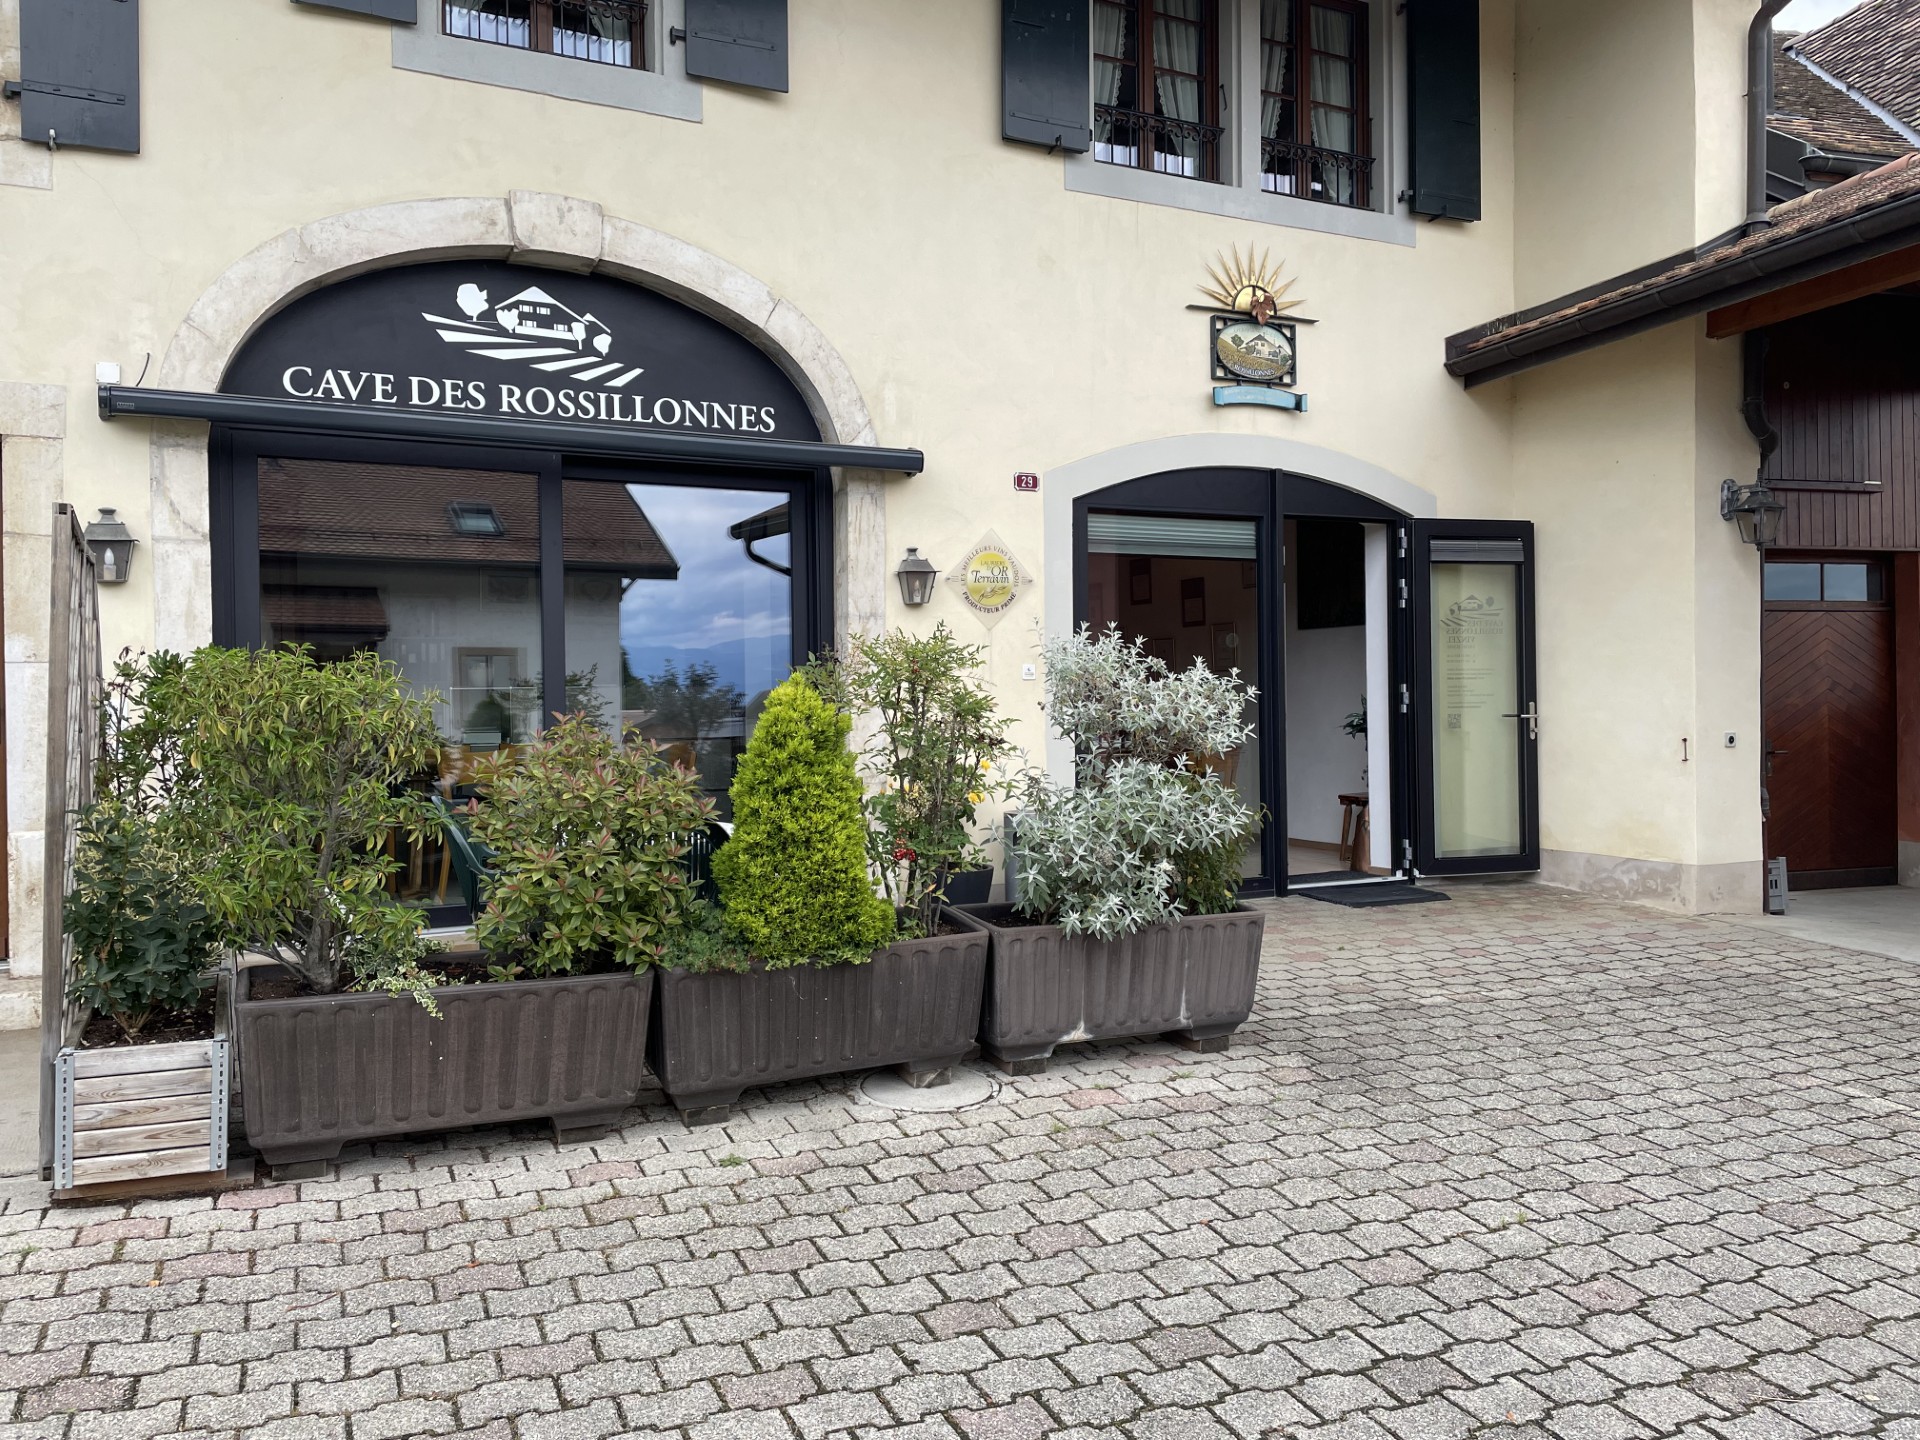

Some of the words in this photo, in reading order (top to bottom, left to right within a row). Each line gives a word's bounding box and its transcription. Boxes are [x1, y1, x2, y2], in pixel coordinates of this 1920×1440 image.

[282, 365, 398, 404] CAVE
[408, 376, 486, 410] DES
[498, 384, 776, 433] ROSSILLONNES
[1021, 476, 1033, 488] 29
[994, 546, 1007, 556] VINS
[971, 570, 1009, 583] Terravin
[962, 592, 1000, 613] PRODUCTEUR
